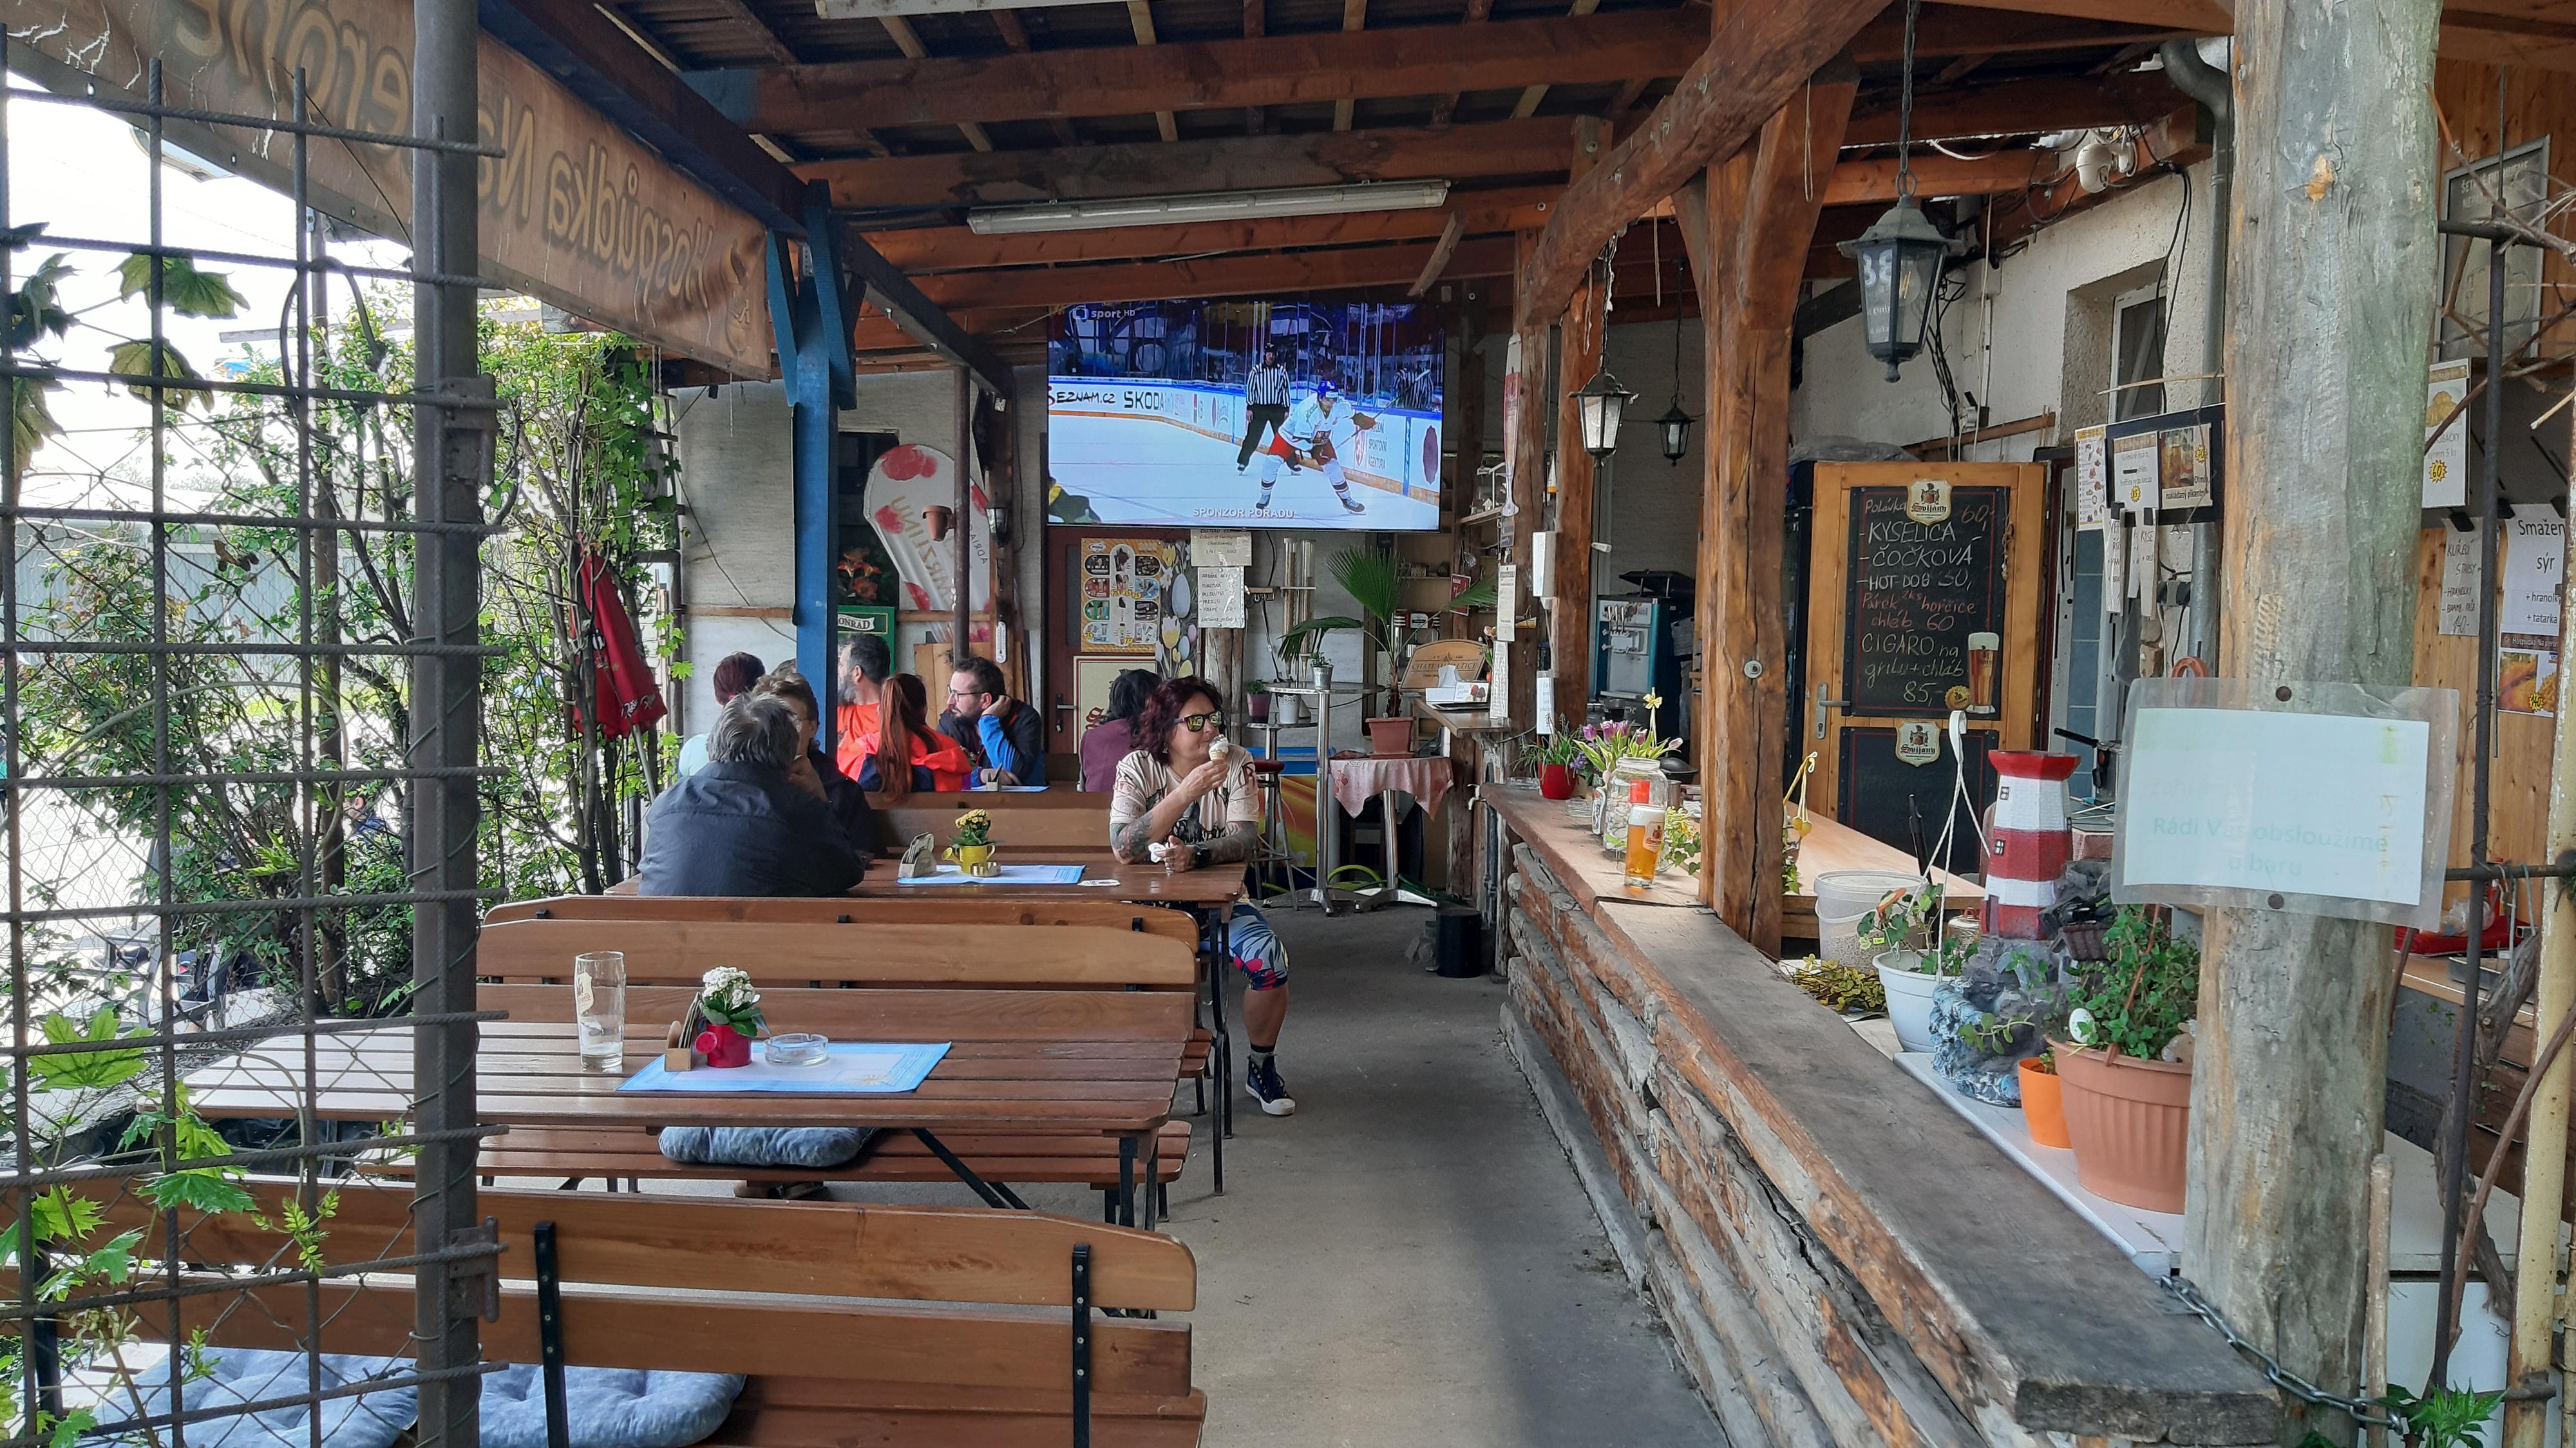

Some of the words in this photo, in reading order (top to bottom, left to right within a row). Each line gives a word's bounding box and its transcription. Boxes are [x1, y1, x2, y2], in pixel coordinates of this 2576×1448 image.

[1090, 309, 1122, 319] sport
[1123, 390, 1165, 411] ŠKODA
[1192, 507, 1245, 518] SPONZOR
[1247, 506, 1294, 519] POŘADU
[1911, 502, 1947, 513] Svijany
[1868, 520, 1956, 544] KYSELICA
[2517, 518, 2565, 536] Smažen
[2536, 552, 2555, 574] sýr
[1861, 591, 1898, 610] Párek
[838, 617, 871, 629] ONRAD
[1926, 613, 1955, 631] 60
[2533, 614, 2558, 624] tatarka
[1900, 743, 1936, 756] Svijany
[2152, 815, 2200, 837] Rádi
[2251, 824, 2390, 853] obsloužíme
[2249, 852, 2304, 877] baru
